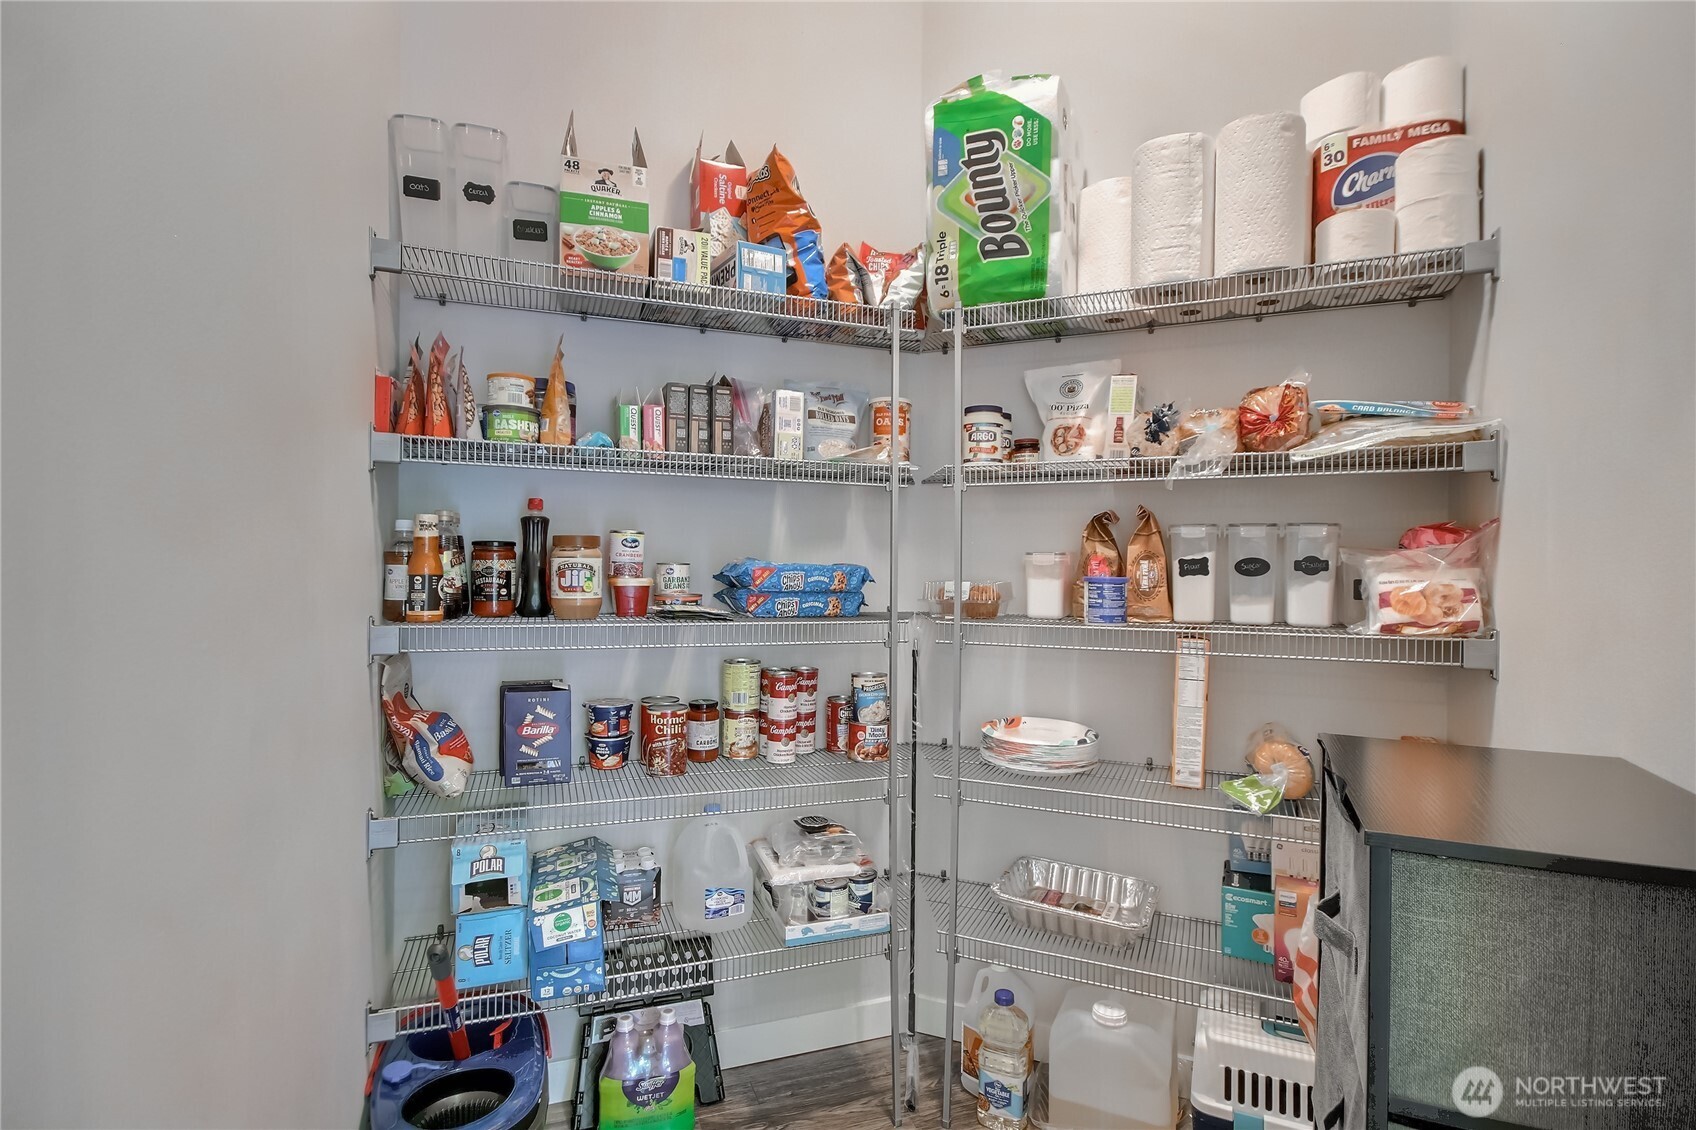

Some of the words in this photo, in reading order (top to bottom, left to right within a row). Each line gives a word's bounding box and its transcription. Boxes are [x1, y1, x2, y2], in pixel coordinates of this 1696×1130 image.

[1352, 130, 1403, 148] FAMILY
[1408, 121, 1450, 138] MEGA
[564, 159, 580, 170] 48
[1323, 150, 1345, 167] 30
[1008, 162, 1019, 179] Upper
[1341, 165, 1396, 197] Charm
[590, 185, 621, 195] QUAKER
[718, 173, 727, 204] Saltine
[1012, 179, 1022, 197] Picker
[965, 129, 1031, 262] Bounty
[591, 204, 615, 213] APPLES
[1016, 197, 1028, 220] Quicker
[589, 210, 622, 220] CINNAMON
[1024, 220, 1032, 232] The
[935, 231, 948, 263] Triple
[701, 250, 709, 270] VALUE
[868, 262, 890, 271] CHIPS
[1352, 404, 1376, 412] CARB
[1377, 406, 1417, 415] BALANCE
[495, 419, 539, 433] CASHEWS
[876, 418, 904, 426] OAS
[971, 432, 995, 441] ARGO
[1241, 562, 1262, 571] Sugar
[782, 575, 801, 585] Chips
[777, 600, 795, 611] Chips
[650, 714, 686, 724] Hormel
[522, 726, 554, 735] Barilla
[655, 724, 682, 735] Chili
[424, 760, 435, 776] Rice
[472, 858, 503, 875] POLAR
[624, 890, 641, 902] MM
[1232, 895, 1267, 906] ecosmart
[473, 935, 491, 967] POLAR
[504, 929, 512, 965] SELTZER
[635, 1079, 664, 1091] Swiffer
[636, 1092, 665, 1101] WETJET
